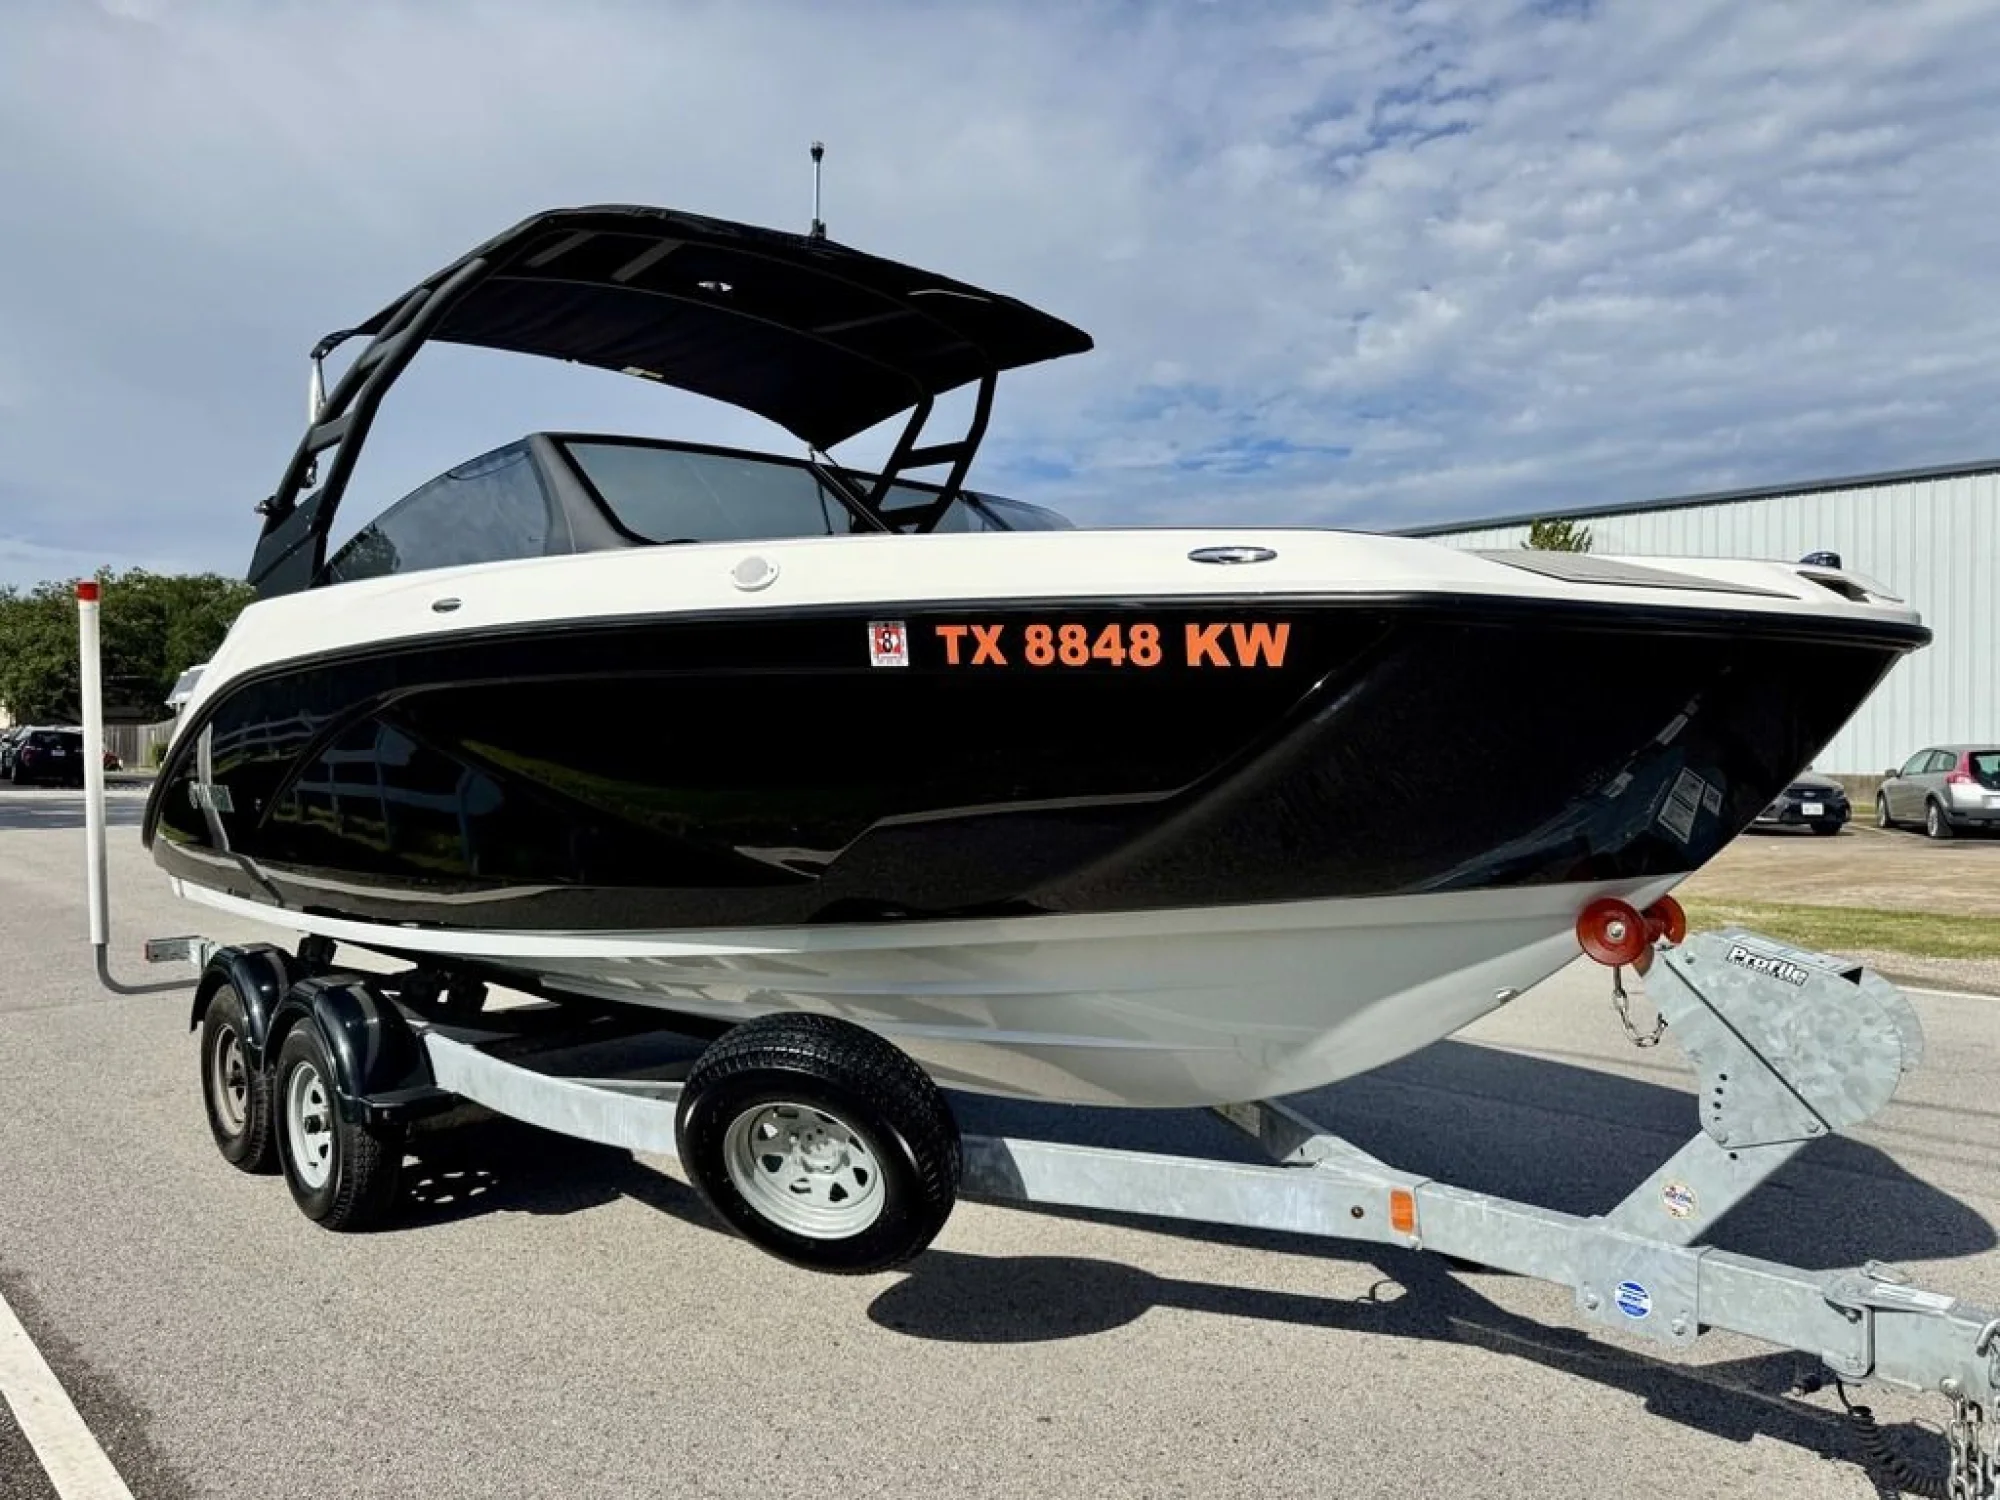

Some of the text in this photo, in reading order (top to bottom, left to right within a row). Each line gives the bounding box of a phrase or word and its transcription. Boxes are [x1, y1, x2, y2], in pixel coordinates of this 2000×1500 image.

[882, 630, 893, 653] 8
[936, 624, 1289, 666] TX 8848 KW
